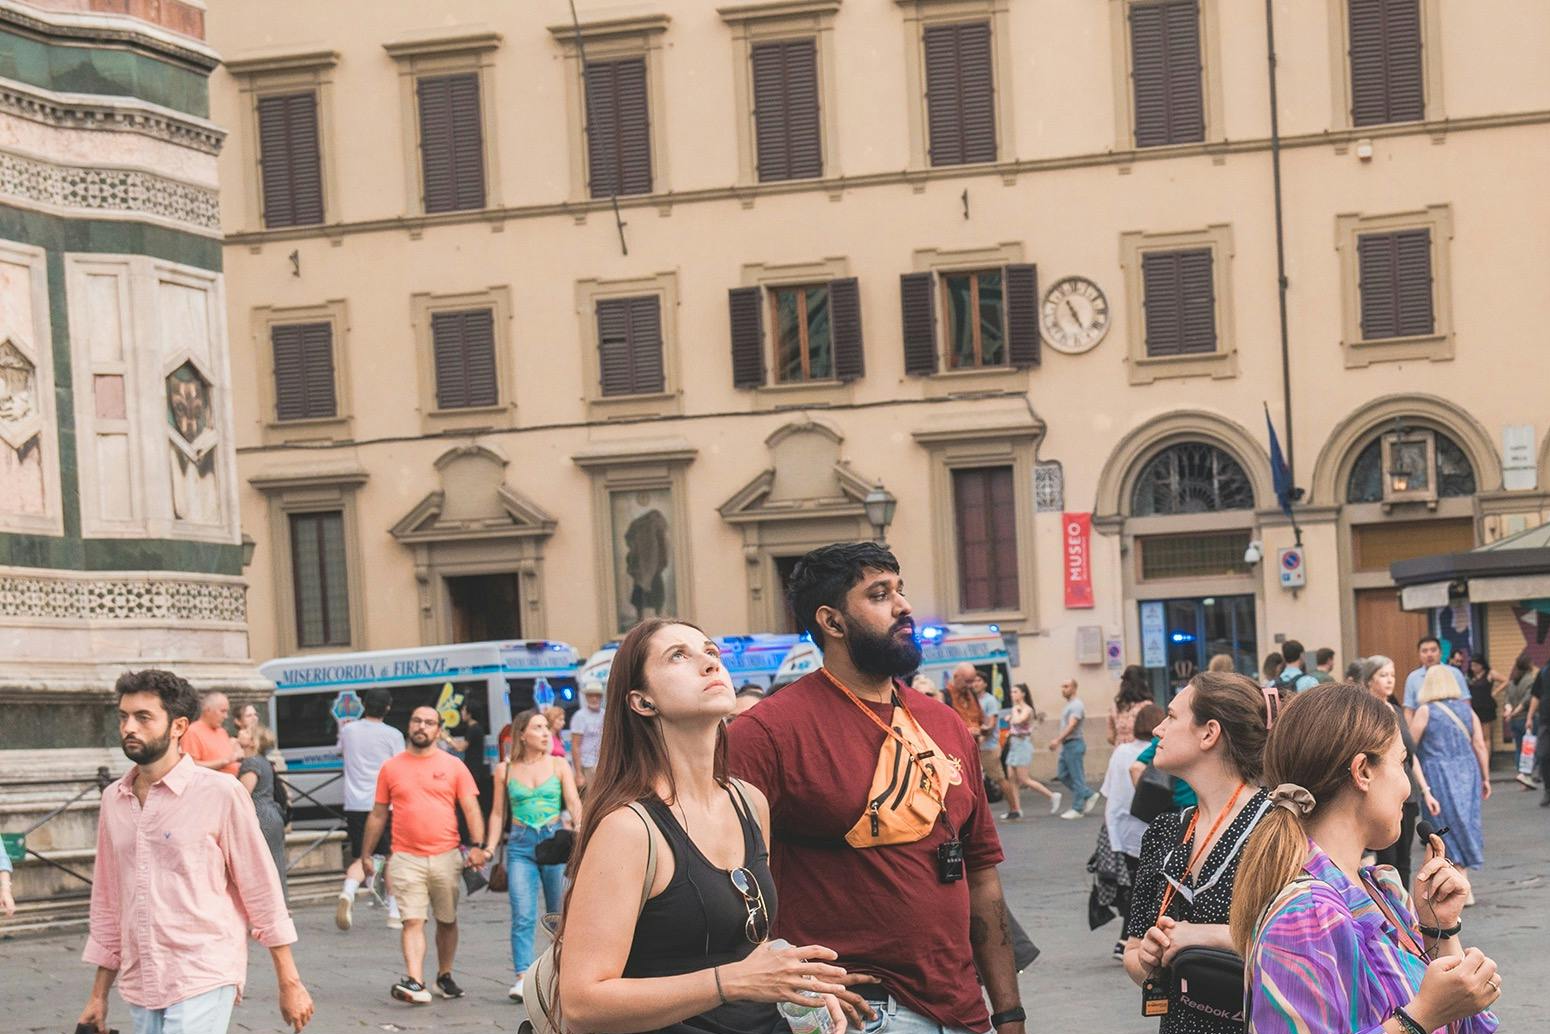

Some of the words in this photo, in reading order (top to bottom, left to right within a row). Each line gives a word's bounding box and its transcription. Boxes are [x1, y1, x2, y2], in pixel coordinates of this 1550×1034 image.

[1068, 522, 1082, 581] MUSEO
[283, 663, 376, 683] MISERICORDIA
[394, 657, 449, 674] FIRENZE
[1180, 995, 1231, 1019] Reebok
